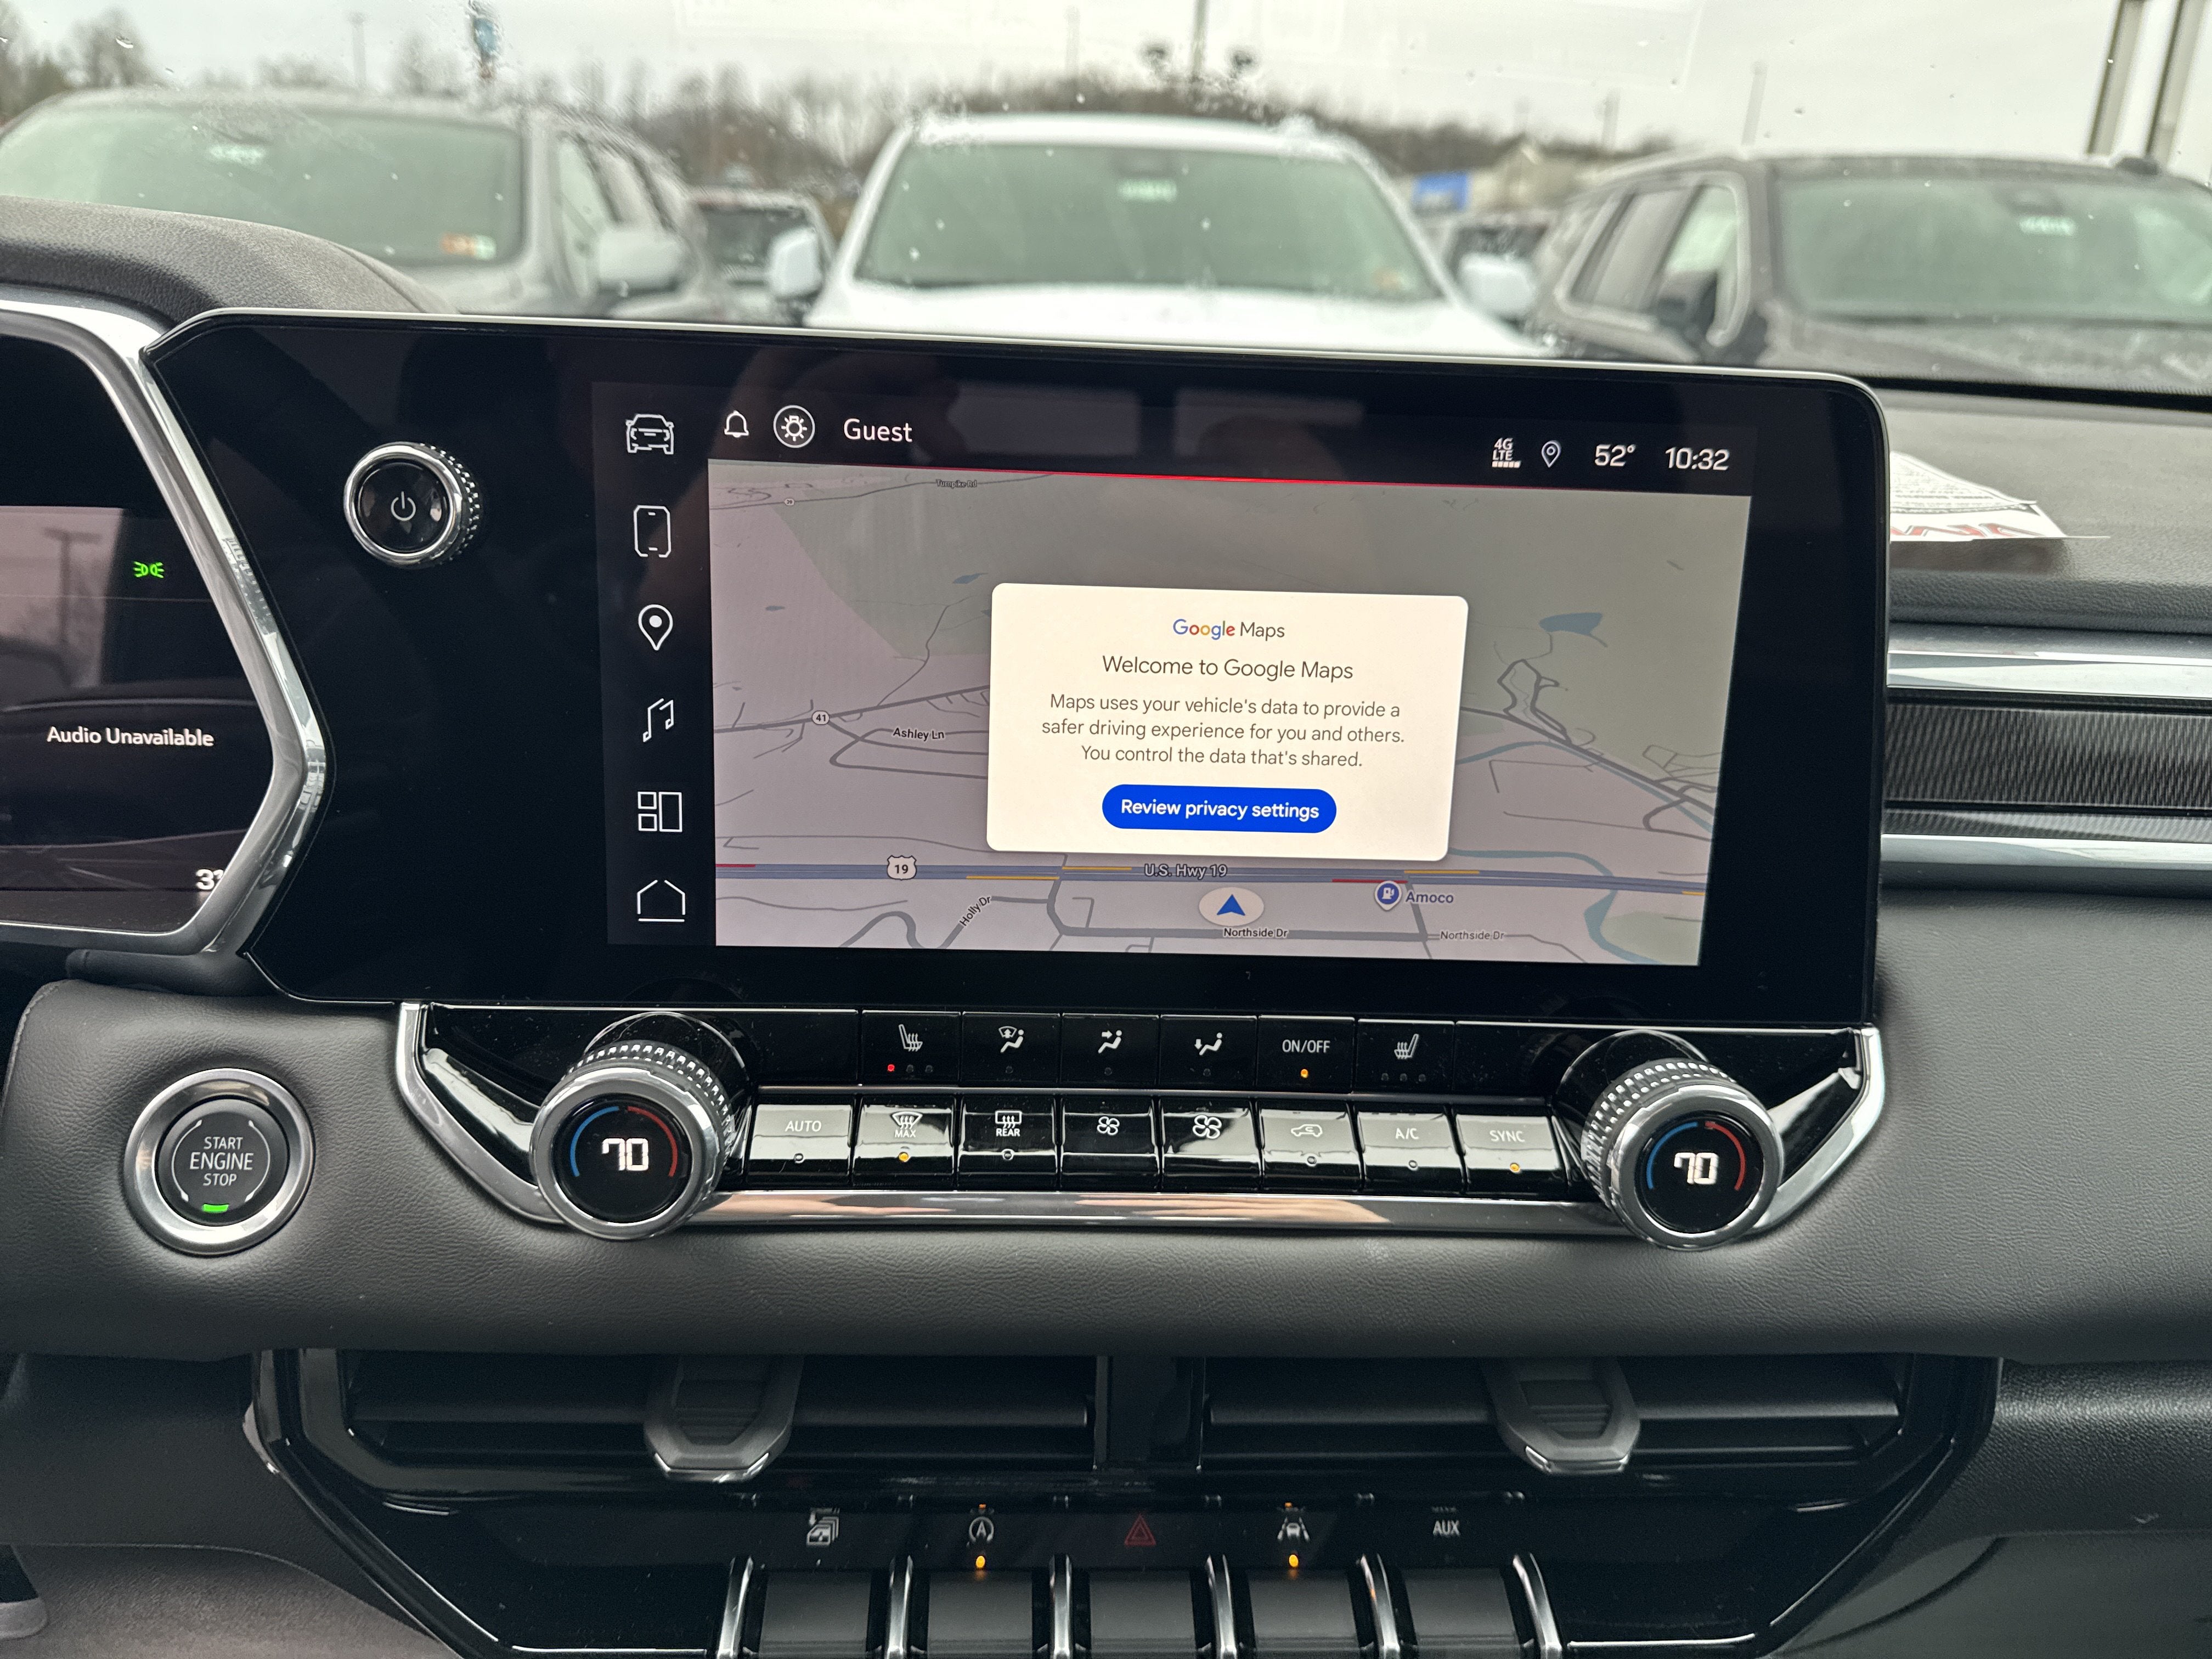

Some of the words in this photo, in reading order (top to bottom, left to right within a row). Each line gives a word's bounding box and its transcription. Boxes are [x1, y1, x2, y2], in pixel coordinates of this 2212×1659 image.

[843, 418, 912, 442] Guest
[1494, 437, 1513, 450] 4G
[1492, 450, 1513, 460] LTE
[1665, 447, 1730, 471] 10:32
[1172, 618, 1235, 641] Google
[1240, 622, 1285, 642] Maps
[1102, 655, 1193, 675] Welcome
[1199, 659, 1218, 675] to
[1224, 658, 1295, 682] Google
[1301, 661, 1353, 683] Maps
[1051, 693, 1095, 713] Maps
[1100, 698, 1138, 710] uses
[1142, 699, 1181, 715] your
[1185, 697, 1256, 714] vehicle's
[1261, 698, 1297, 715] data
[1302, 701, 1319, 715] to
[1323, 701, 1386, 719] provide
[1390, 706, 1400, 718] a
[816, 714, 826, 722] 41
[46, 726, 102, 743] Audio
[105, 727, 215, 747] Unavailable
[893, 727, 929, 741] Ashley
[932, 729, 945, 740] Ln
[1042, 718, 1085, 735] safer
[1089, 719, 1146, 740] driving
[1151, 722, 1244, 741] experience
[1249, 723, 1273, 740] for
[1277, 729, 1306, 743] you
[1311, 726, 1342, 741] and
[1347, 726, 1404, 743] others.
[1081, 745, 1110, 760] You
[1115, 747, 1172, 762] control
[1177, 747, 1205, 763] the
[1209, 748, 1245, 764] data
[1250, 749, 1297, 765] that's
[1301, 750, 1362, 767] shared.
[1121, 798, 1182, 815] Review
[1185, 800, 1249, 820] privacy
[1251, 802, 1319, 822] settings
[894, 864, 909, 874] 19
[1144, 864, 1172, 877] U.S.
[1176, 864, 1206, 880] Hwy
[1209, 865, 1227, 877] 19
[1406, 891, 1454, 904] Amoco
[960, 904, 981, 926] Holly
[979, 896, 991, 907] Dr
[1223, 927, 1273, 938] Northside
[1276, 928, 1287, 938] Dr
[1441, 930, 1490, 940] Northside
[1493, 931, 1505, 940] Dr
[1282, 1039, 1330, 1053] ON/OFF
[785, 1120, 822, 1132] AUTO
[996, 1126, 1020, 1137] REAR
[894, 1128, 917, 1139] MAX
[1395, 1127, 1419, 1140] A/C
[1489, 1130, 1526, 1143] SYNC
[204, 1137, 243, 1149] START
[189, 1152, 254, 1171] ENGINE
[601, 1138, 649, 1171] 70
[1673, 1152, 1719, 1185] 70
[202, 1173, 237, 1186] STOP
[1432, 1519, 1461, 1536] AUX
